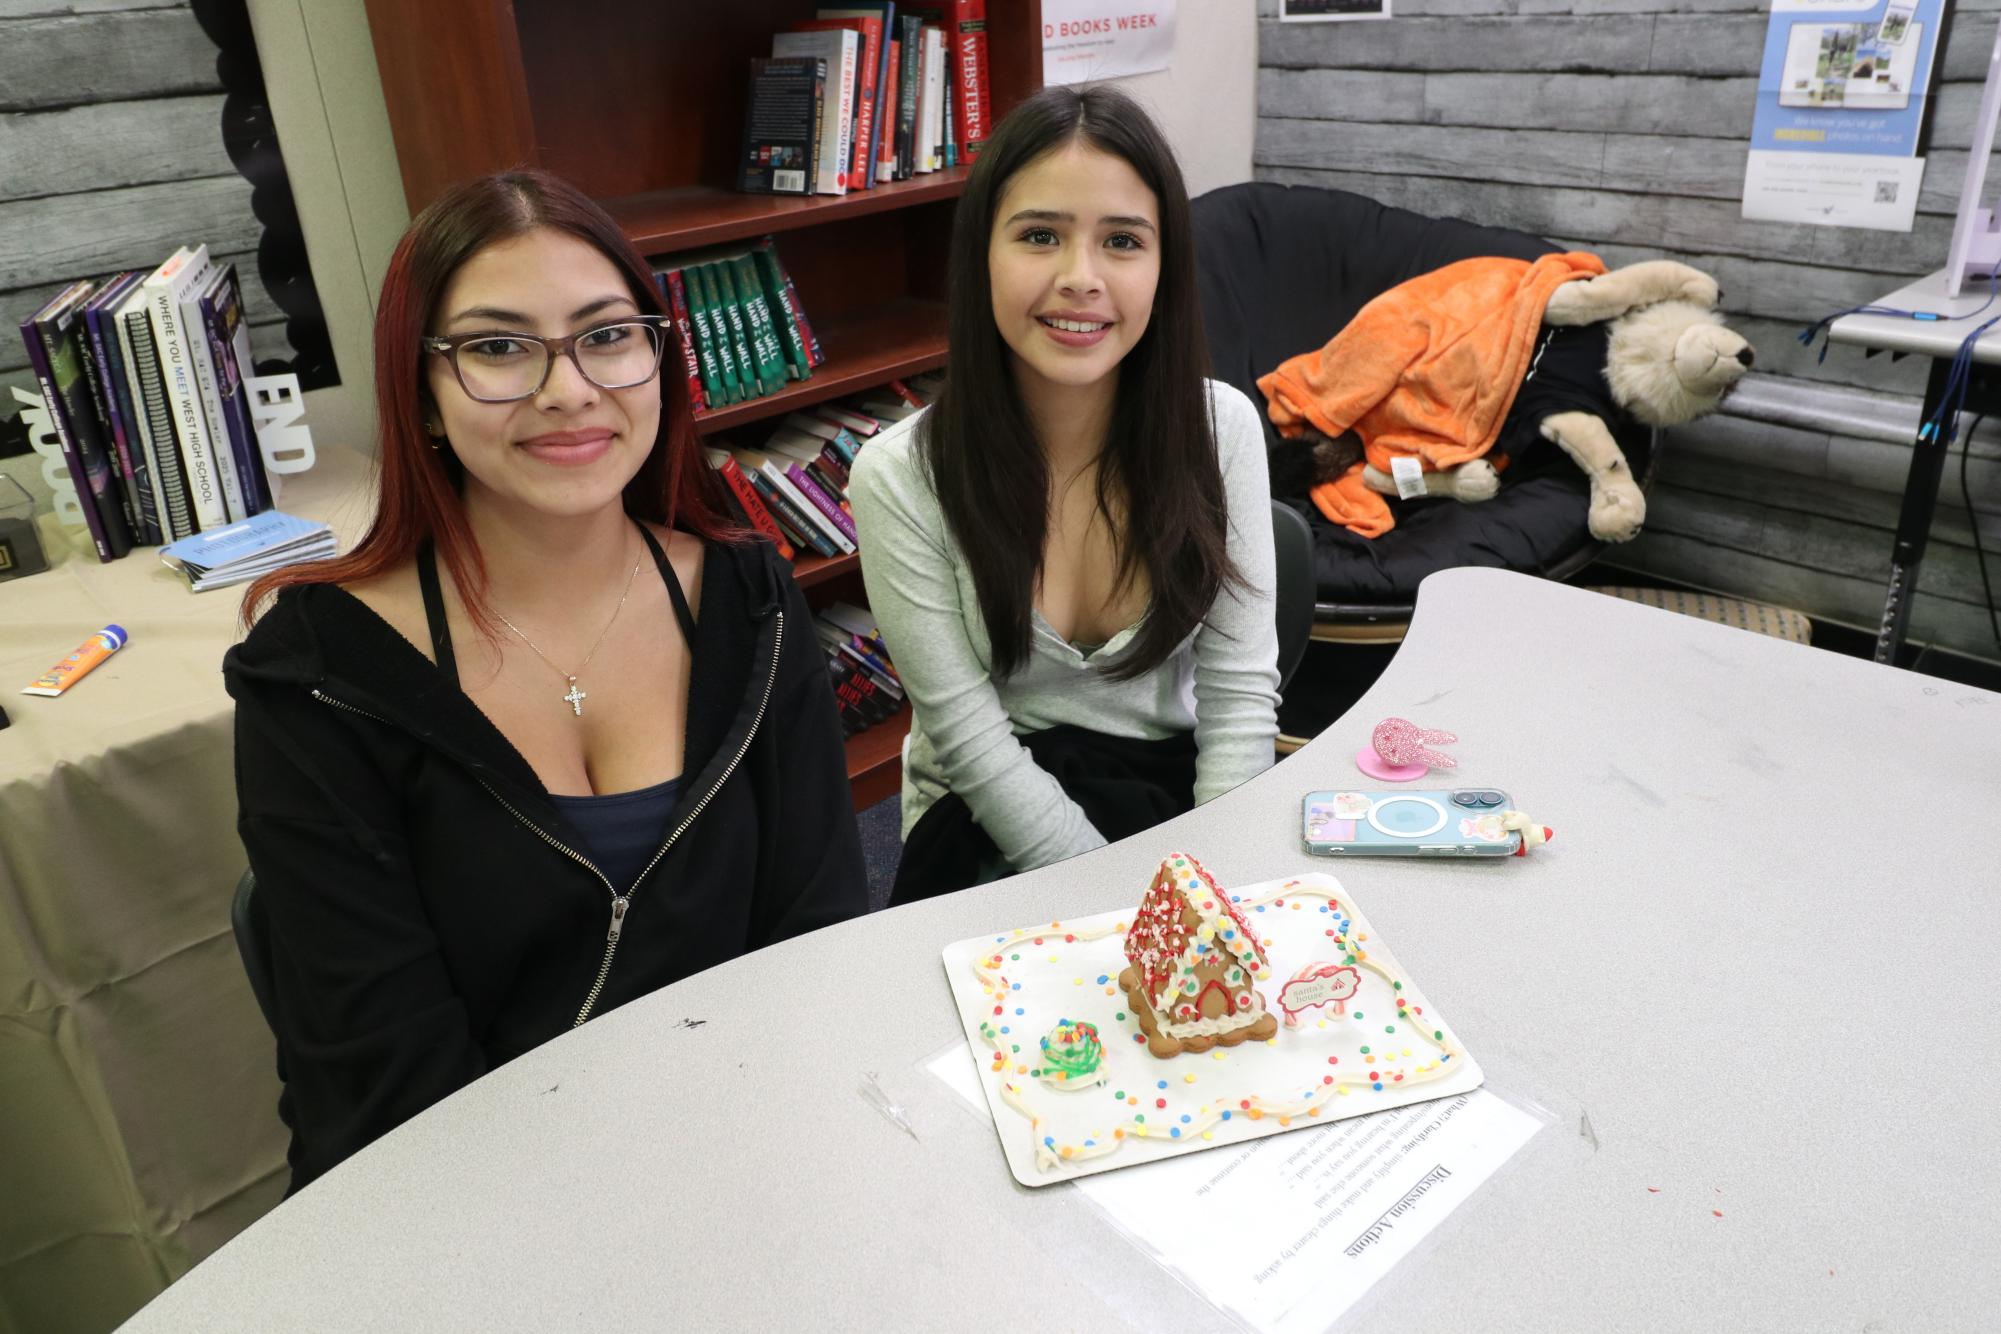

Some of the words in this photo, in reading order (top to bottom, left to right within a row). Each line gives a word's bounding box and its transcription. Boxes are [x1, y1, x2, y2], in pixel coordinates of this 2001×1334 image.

[1060, 19, 1111, 36] BOOKS
[1117, 14, 1157, 30] WEEK
[844, 46, 853, 65] THE
[844, 68, 852, 94] BEST
[961, 36, 981, 139] WEBSTER'S
[843, 97, 851, 114] WE
[840, 116, 850, 155] COULD
[859, 101, 871, 148] HARPER
[857, 153, 866, 173] LEE
[156, 295, 176, 337] WHERE
[694, 311, 711, 339] HAND
[710, 307, 727, 335] HAND
[753, 296, 769, 323] HAND
[763, 332, 779, 360] WALL
[777, 288, 793, 314] HAND
[787, 324, 803, 351] WALL
[727, 304, 743, 331] HAND
[735, 341, 751, 370] WALL
[745, 301, 761, 328] HAND
[753, 338, 769, 366] WALL
[166, 339, 181, 364] YOU
[681, 347, 701, 378] STAIR
[702, 349, 718, 377] WALL
[718, 345, 735, 374] WALL
[98, 368, 111, 389] College
[173, 365, 189, 397] MEET
[103, 387, 117, 413] Academy
[180, 398, 197, 430] WEST
[246, 372, 316, 475] END
[188, 430, 203, 458] HIGH
[194, 460, 213, 504] SCHOOL
[731, 470, 748, 494] THE
[742, 490, 763, 519] HATE
[759, 516, 769, 528] U
[797, 475, 810, 488] THE
[807, 486, 837, 516] LIGHTNESS
[833, 512, 844, 522] OF
[840, 521, 860, 540] HAND
[1398, 1117, 1442, 1157] Clarifying:
[1339, 1145, 1357, 1162] you
[1371, 1149, 1405, 1182] simplify
[1313, 1191, 1332, 1210] said
[1339, 1188, 1363, 1210] make
[1358, 1176, 1376, 1194] and
[1388, 1163, 1452, 1223] Discussion
[1315, 1204, 1344, 1231] things
[1278, 1245, 1295, 1263] by
[1345, 1215, 1395, 1263] Actions
[1250, 1255, 1285, 1288] asking
